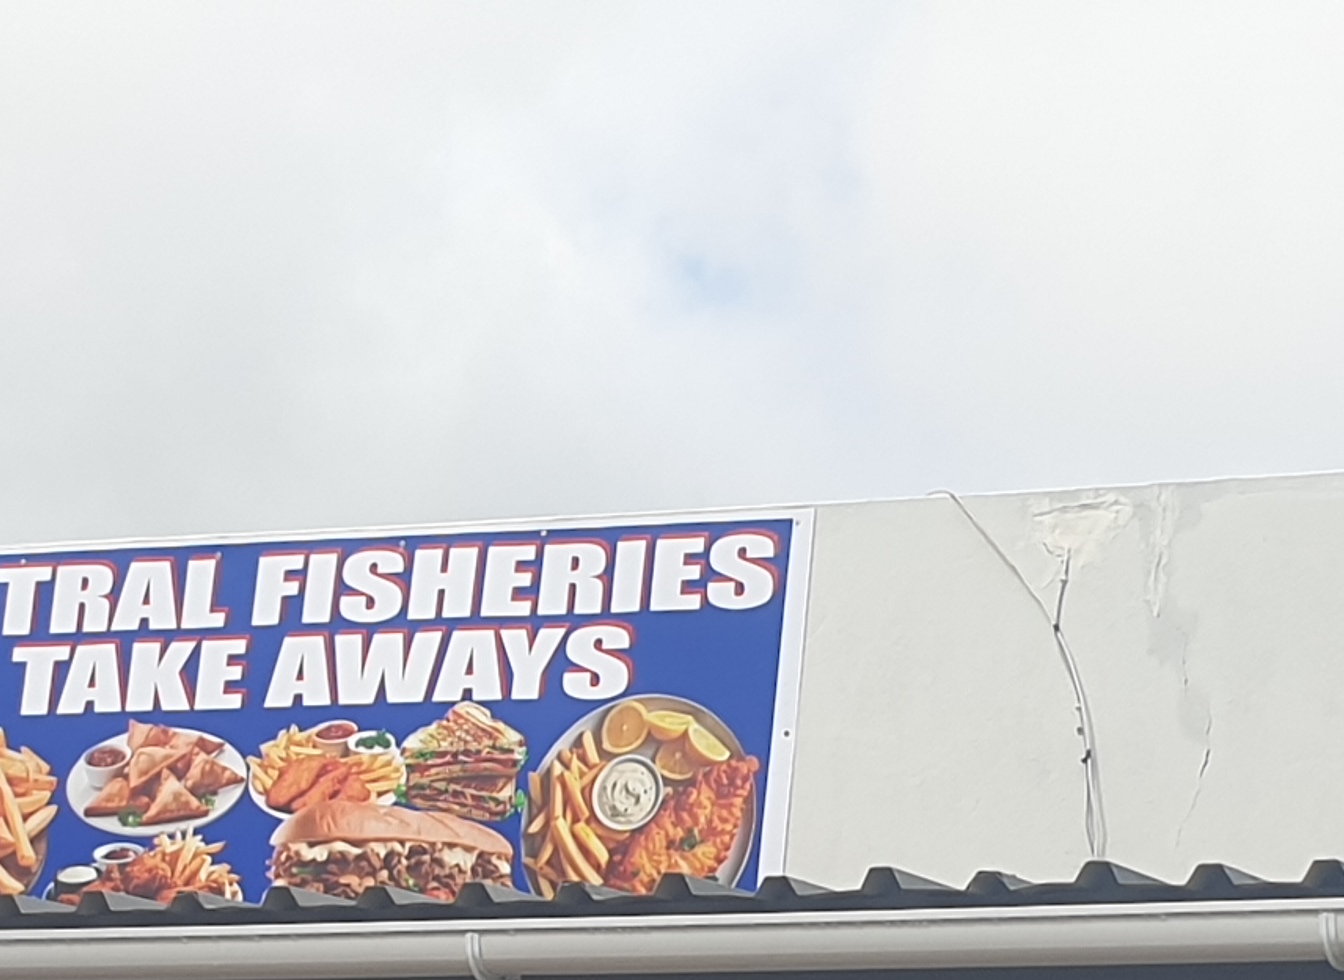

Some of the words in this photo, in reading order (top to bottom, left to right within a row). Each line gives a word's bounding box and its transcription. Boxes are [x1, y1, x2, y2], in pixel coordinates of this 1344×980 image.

[251, 532, 777, 626] FISHERIES
[13, 636, 251, 716] TAKE
[262, 621, 634, 709] AWAYS
